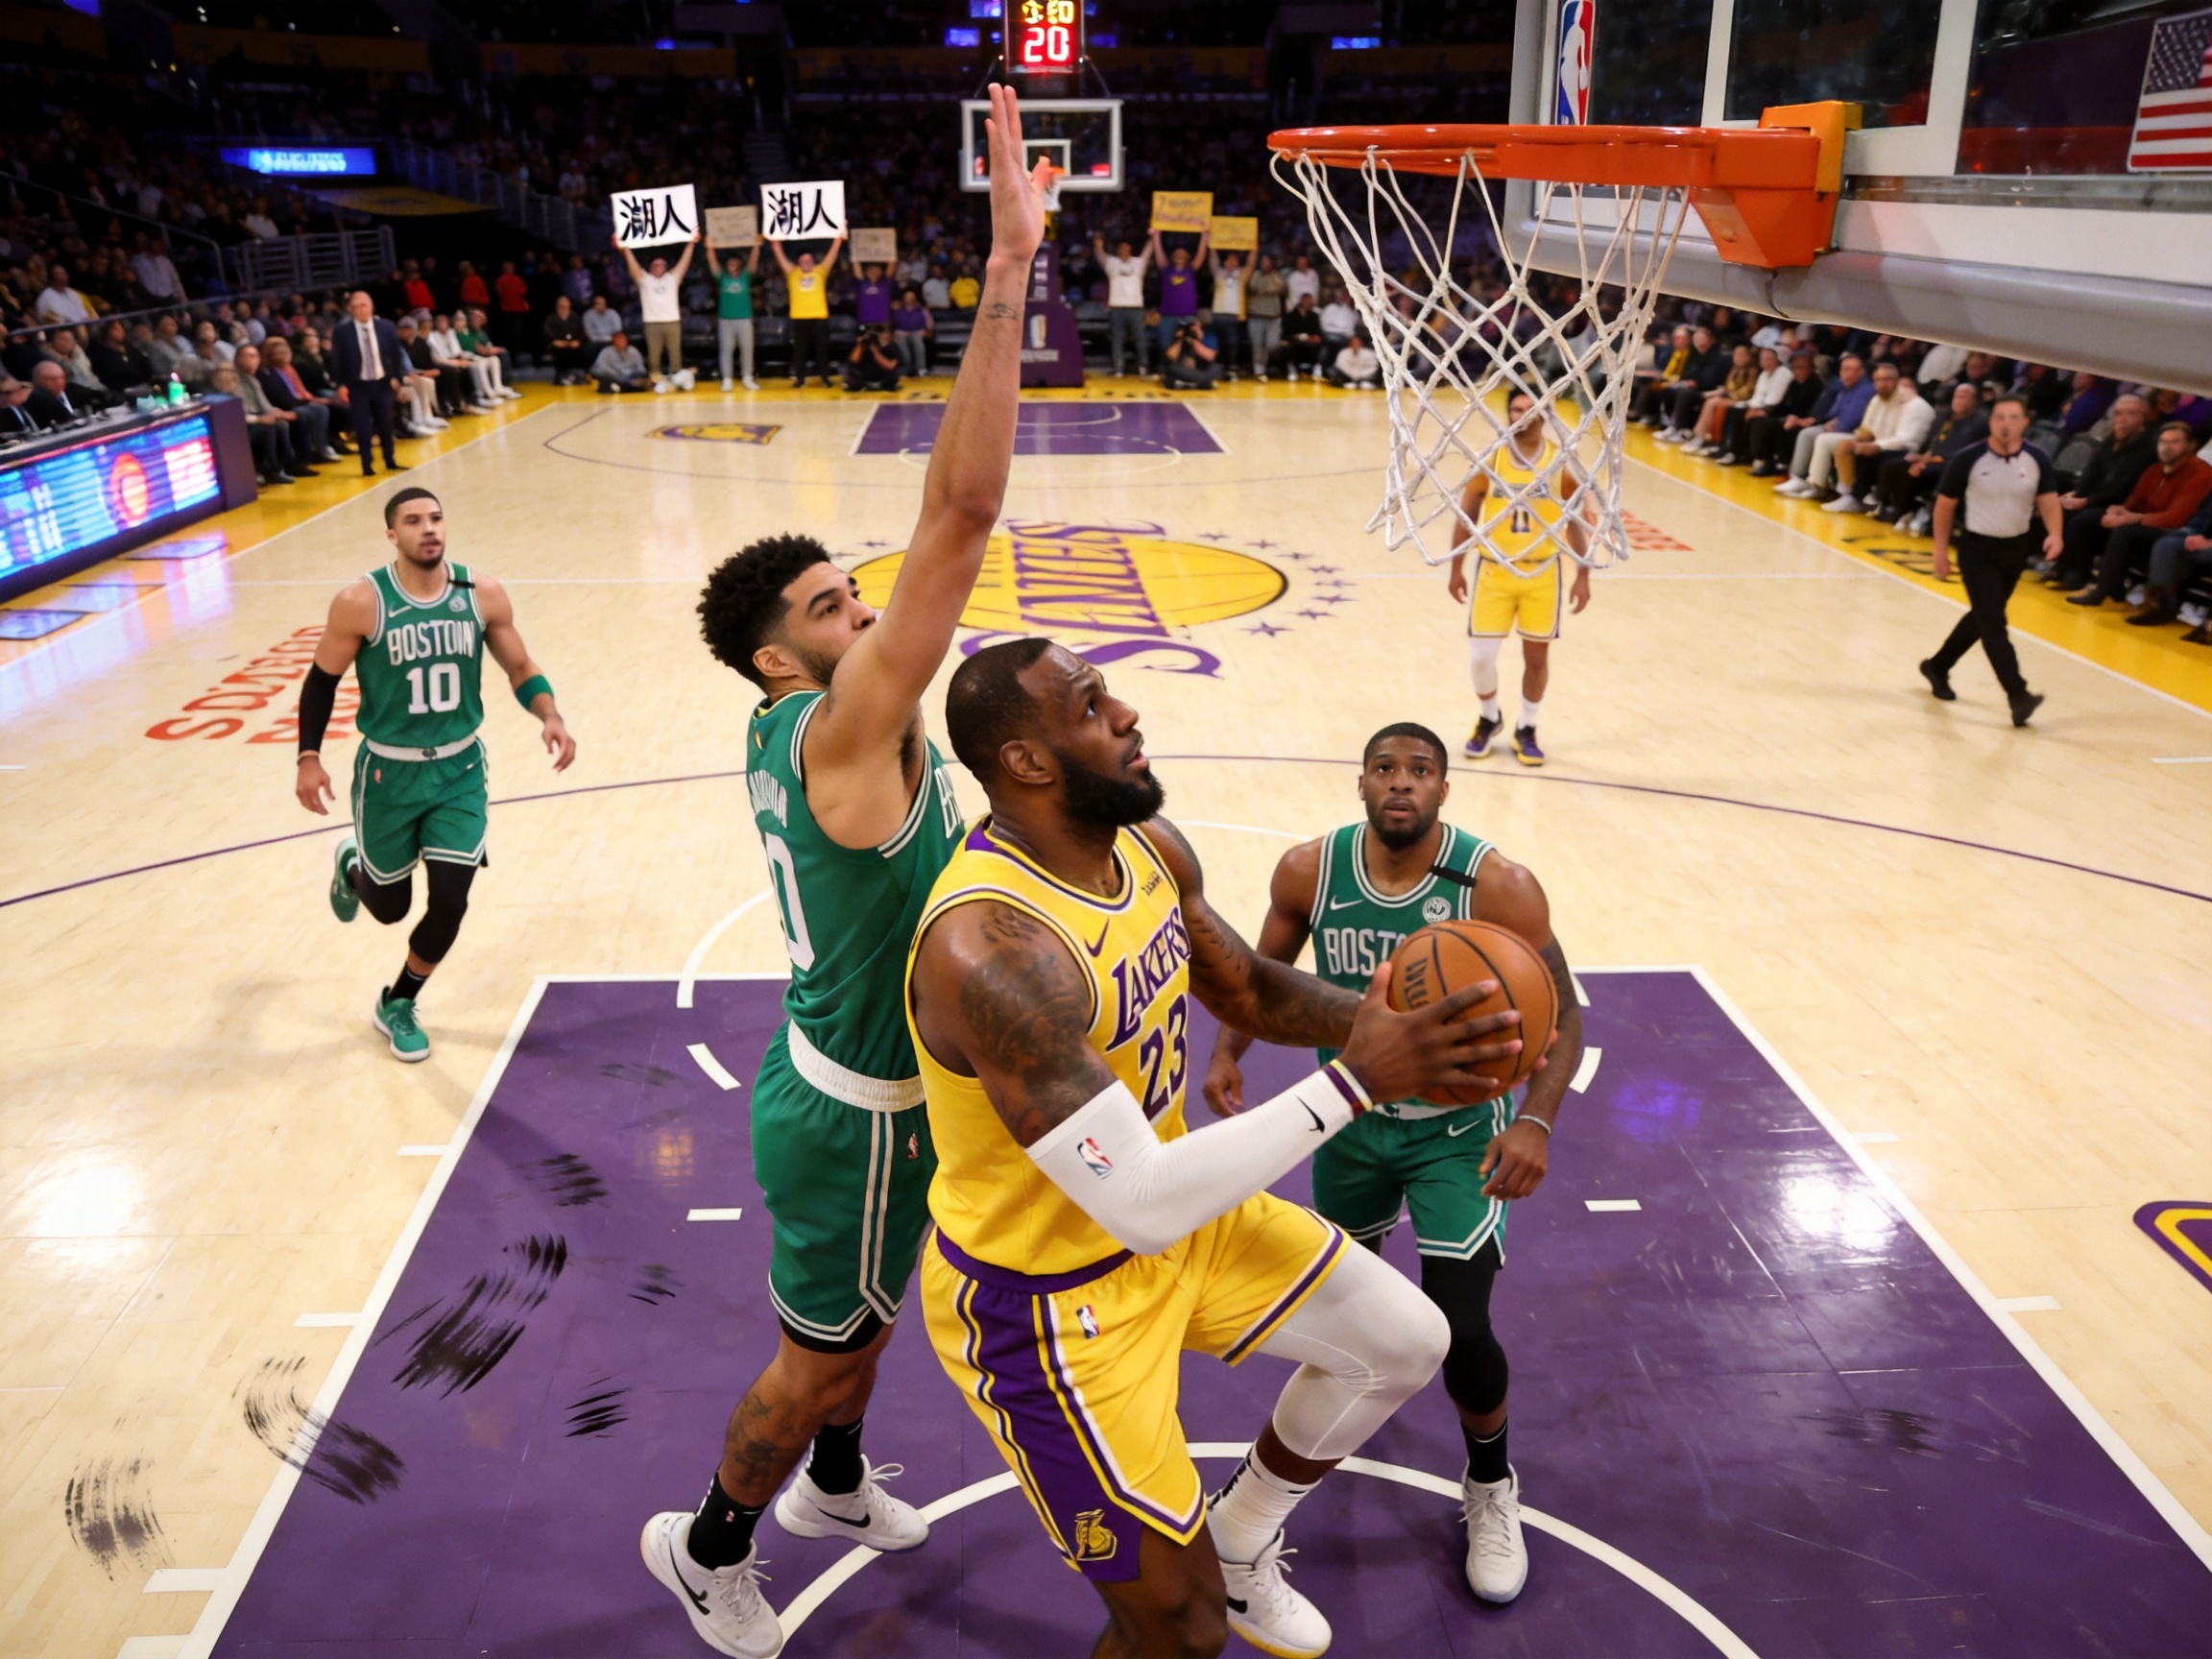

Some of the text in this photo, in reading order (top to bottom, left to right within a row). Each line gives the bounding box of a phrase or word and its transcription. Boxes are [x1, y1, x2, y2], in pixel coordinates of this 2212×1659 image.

[1024, 26, 1070, 62] 20
[619, 195, 692, 240] 湖人
[768, 189, 839, 235] 湖人
[405, 662, 461, 714] 10
[1322, 927, 1407, 976] BOST
[1105, 905, 1191, 1052] LAKERS
[1139, 993, 1189, 1122] 23
